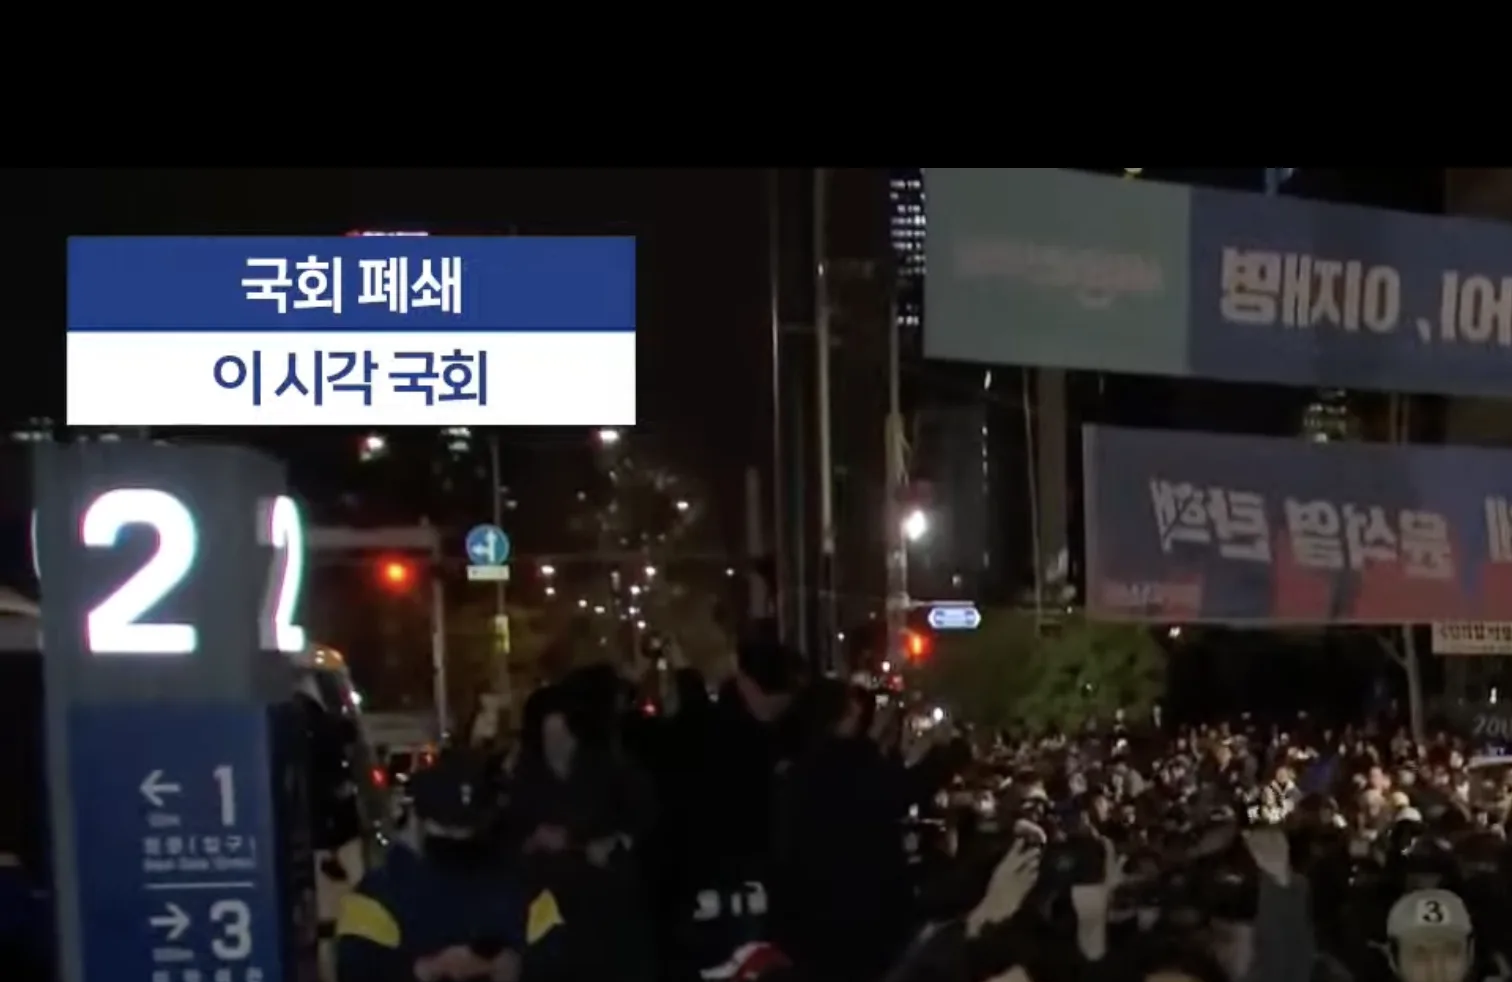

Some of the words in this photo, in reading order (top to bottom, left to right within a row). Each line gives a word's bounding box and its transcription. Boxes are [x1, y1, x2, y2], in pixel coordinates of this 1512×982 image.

[82, 488, 198, 654] 2
[212, 765, 235, 826] 1
[210, 899, 252, 960] 3
[1422, 900, 1444, 924] 3
